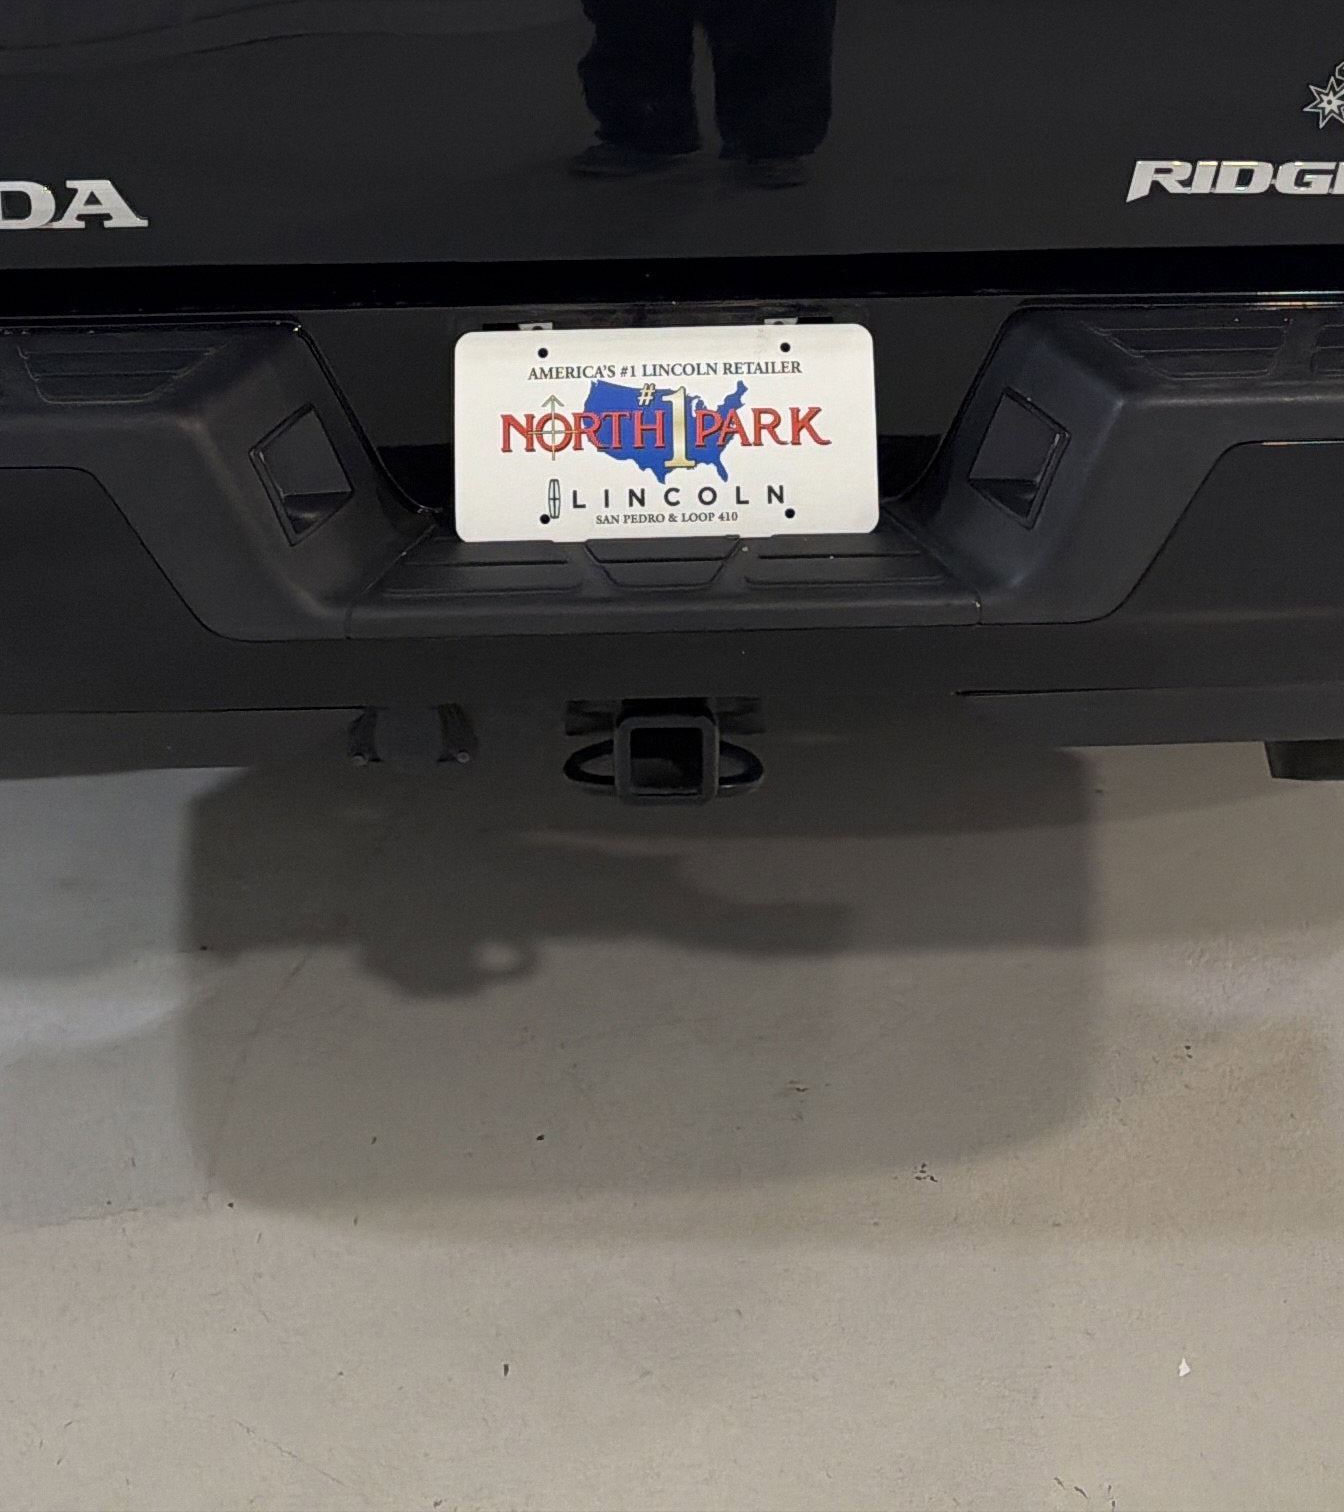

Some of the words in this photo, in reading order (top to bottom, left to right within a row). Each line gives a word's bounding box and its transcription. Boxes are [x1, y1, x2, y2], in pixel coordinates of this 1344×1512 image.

[528, 364, 616, 381] AMERICA'S
[620, 364, 637, 378] #1
[641, 362, 718, 377] LINCOLN
[722, 360, 803, 375] RETAILER
[500, 409, 666, 453] NORTH
[694, 406, 832, 448] PARK
[572, 485, 785, 509] LINCOLN
[595, 514, 620, 525] SAN
[622, 513, 666, 524] PEDRO
[668, 513, 678, 523] &
[681, 512, 716, 523] LOOP
[718, 511, 738, 522] 410
